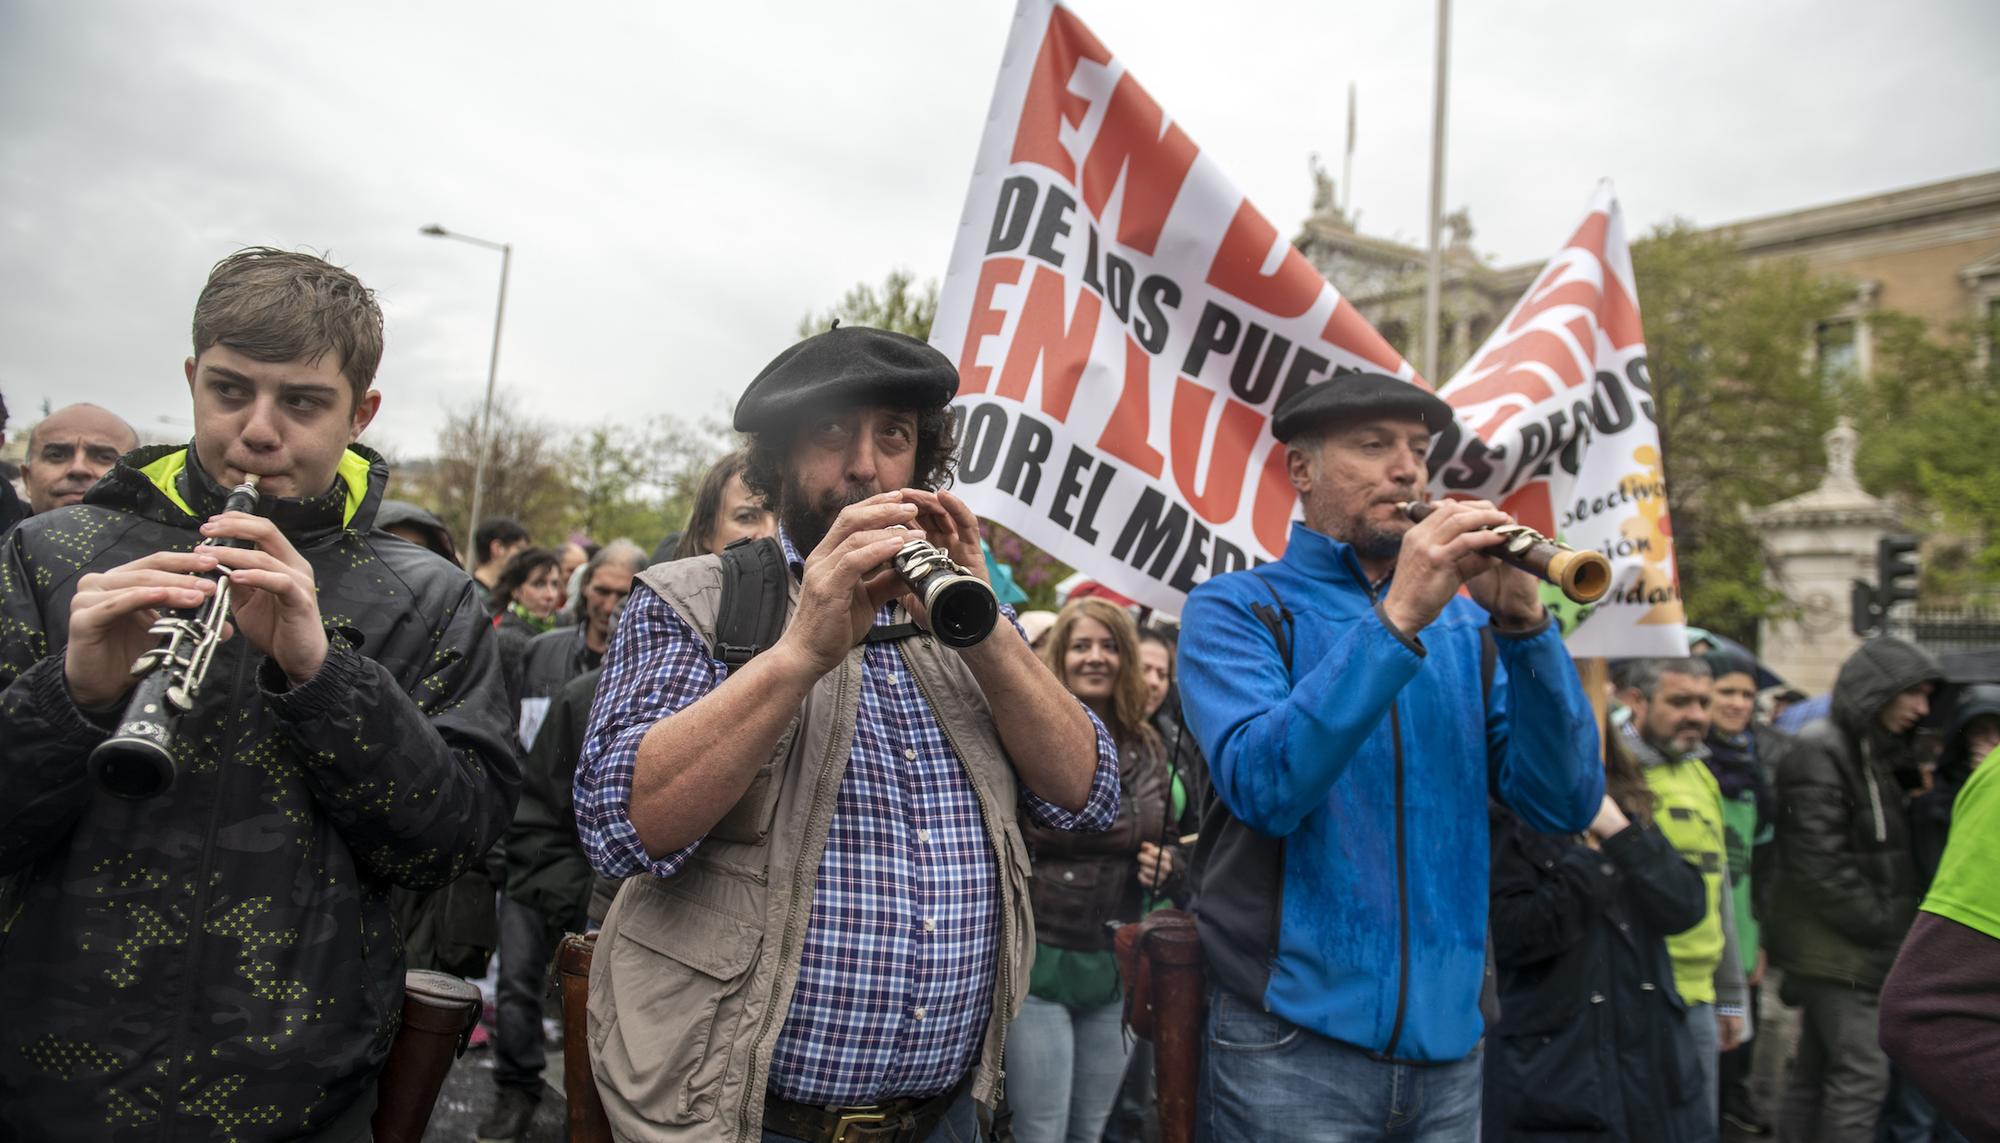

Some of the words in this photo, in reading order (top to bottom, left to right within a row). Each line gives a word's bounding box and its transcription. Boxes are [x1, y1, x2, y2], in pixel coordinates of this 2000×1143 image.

[957, 257, 1103, 425] EN
[986, 175, 1077, 268] DE
[1083, 222, 1183, 356] LOS
[1048, 445, 1117, 546] EL
